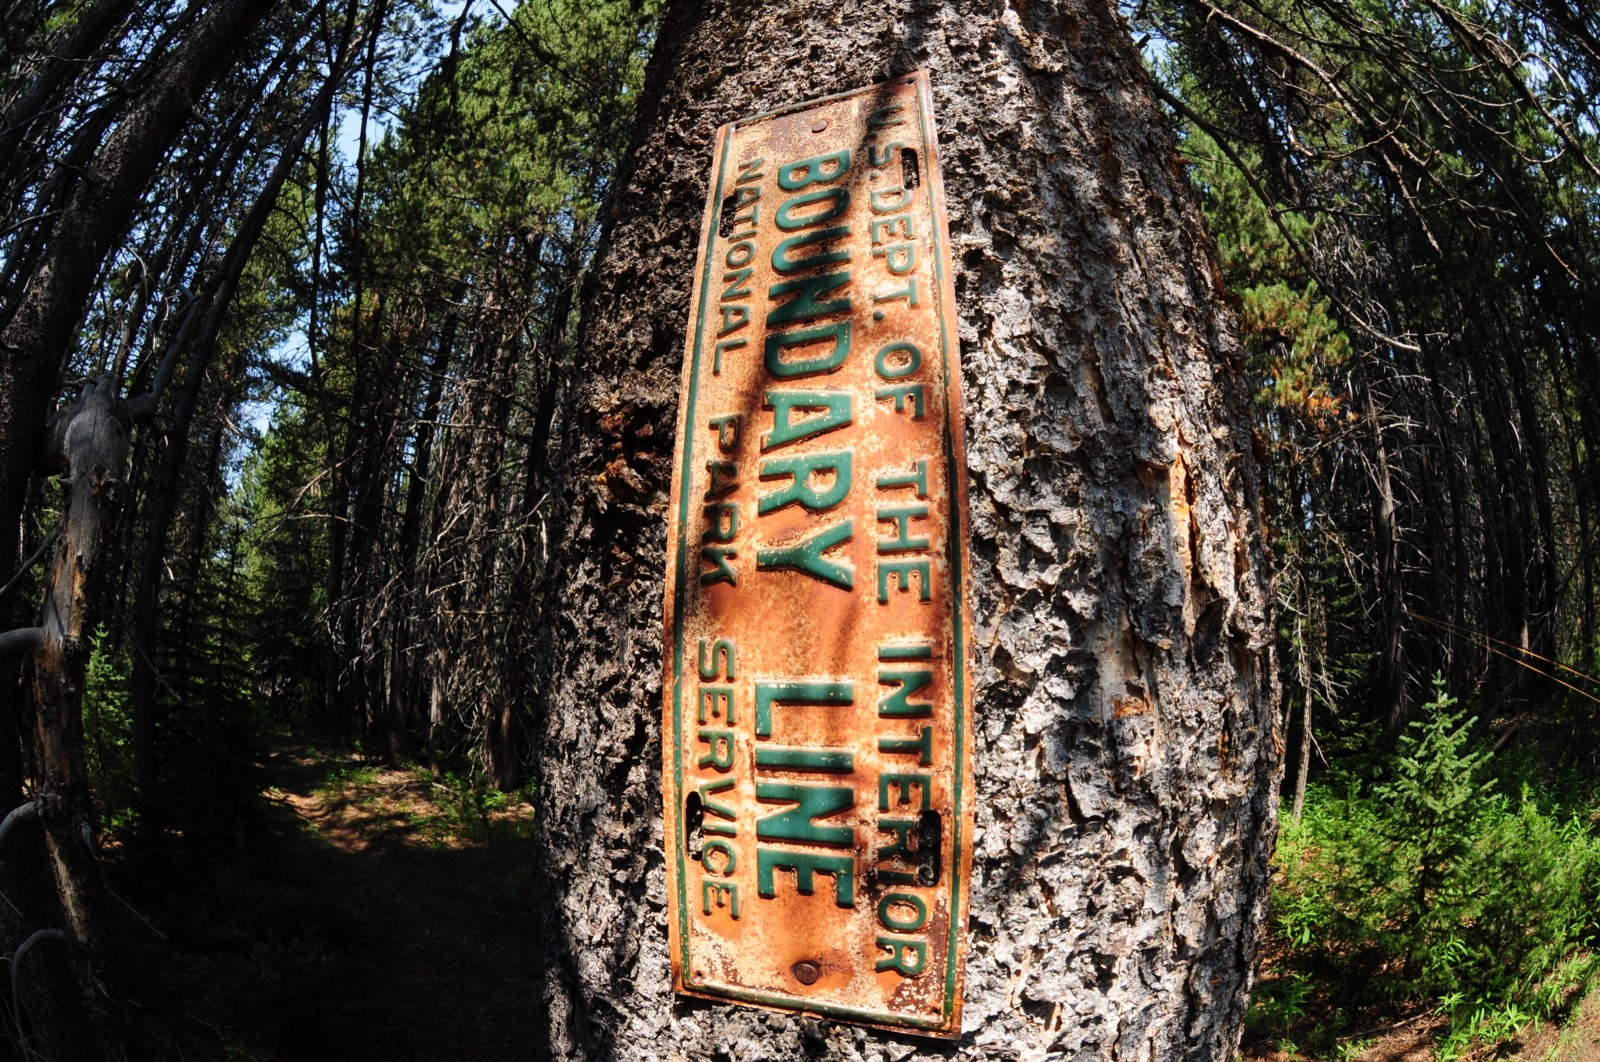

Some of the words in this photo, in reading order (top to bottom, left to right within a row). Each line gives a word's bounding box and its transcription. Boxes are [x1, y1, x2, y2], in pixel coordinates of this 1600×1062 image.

[712, 156, 765, 376] NATIONAL
[869, 186, 920, 321] DEPT.
[756, 149, 853, 592] BOUNDARY
[874, 341, 925, 418] OF
[699, 412, 744, 587] PARK
[876, 459, 931, 605] THE
[697, 638, 740, 920] SERVICE
[754, 681, 855, 909] LINE
[875, 645, 933, 977] INTERIOR
